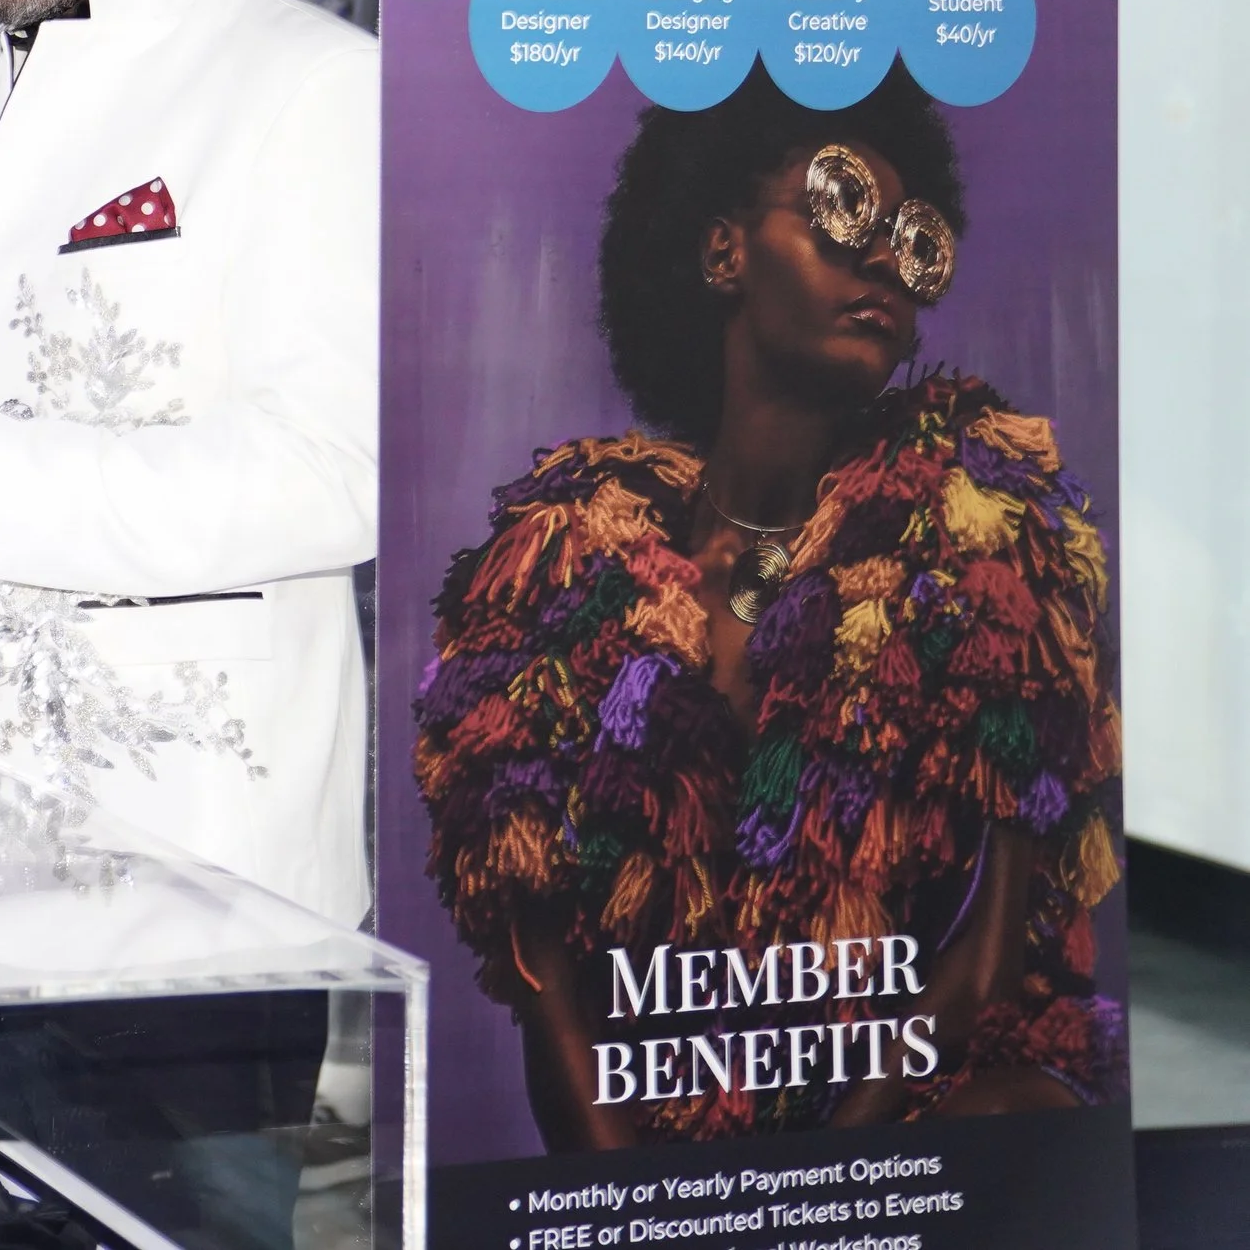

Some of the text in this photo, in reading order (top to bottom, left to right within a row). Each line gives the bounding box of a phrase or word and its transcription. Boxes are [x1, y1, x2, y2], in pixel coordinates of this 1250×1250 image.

[501, 11, 590, 35] Designer
[646, 11, 730, 35] Designer
[788, 12, 867, 31] Creative
[936, 22, 996, 48] $40/yr
[510, 41, 581, 67] $180/yr
[654, 40, 722, 65] $140/yr
[794, 41, 861, 67] $120/yr
[606, 935, 927, 1018] MEMBER
[591, 1013, 938, 1105] BENEFITS
[528, 1154, 942, 1214] Monthly or Yearly Payment Options
[529, 1191, 964, 1250] FREE or Discounted Tickets to Events
